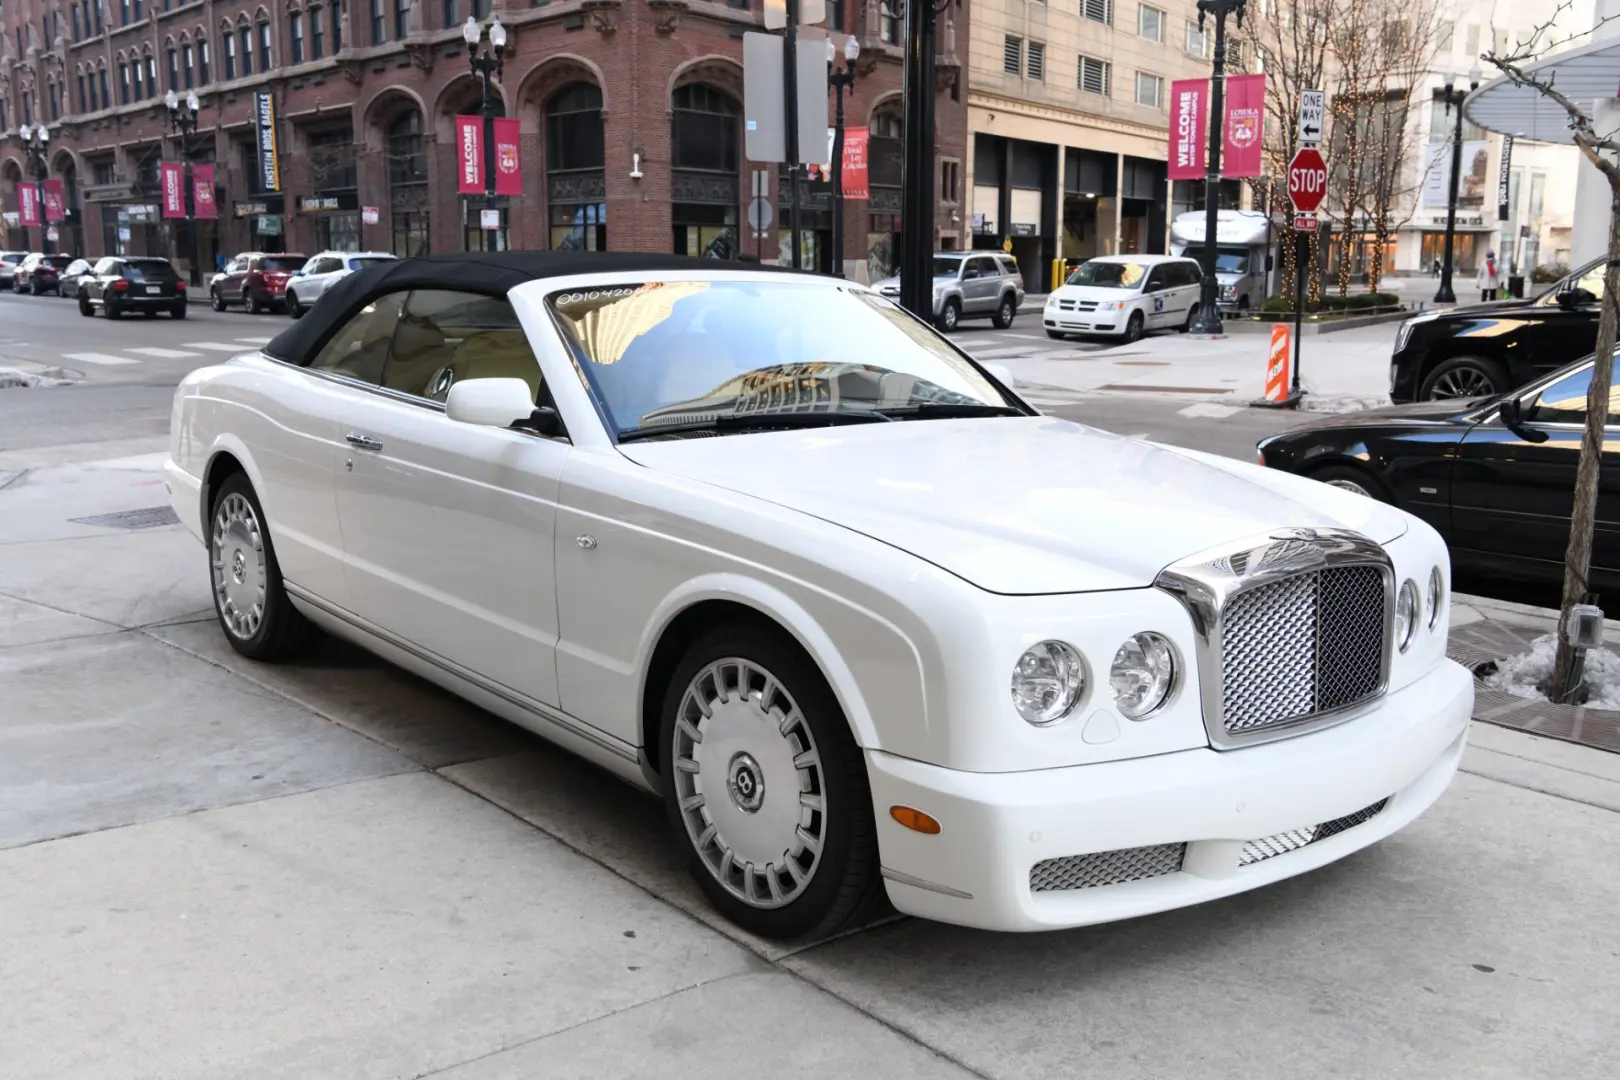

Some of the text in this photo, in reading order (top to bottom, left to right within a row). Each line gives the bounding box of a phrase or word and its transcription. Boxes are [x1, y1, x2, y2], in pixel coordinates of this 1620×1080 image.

[260, 94, 271, 126] BAGELS
[1302, 108, 1321, 121] WAY
[1303, 95, 1322, 107] ONE
[1178, 92, 1191, 168] WELCOME
[463, 124, 474, 184] WELCOME
[263, 152, 275, 189] EINSTEIN
[1290, 168, 1326, 192] STOP
[166, 170, 176, 211] WELCOME
[1296, 220, 1305, 228] ALL
